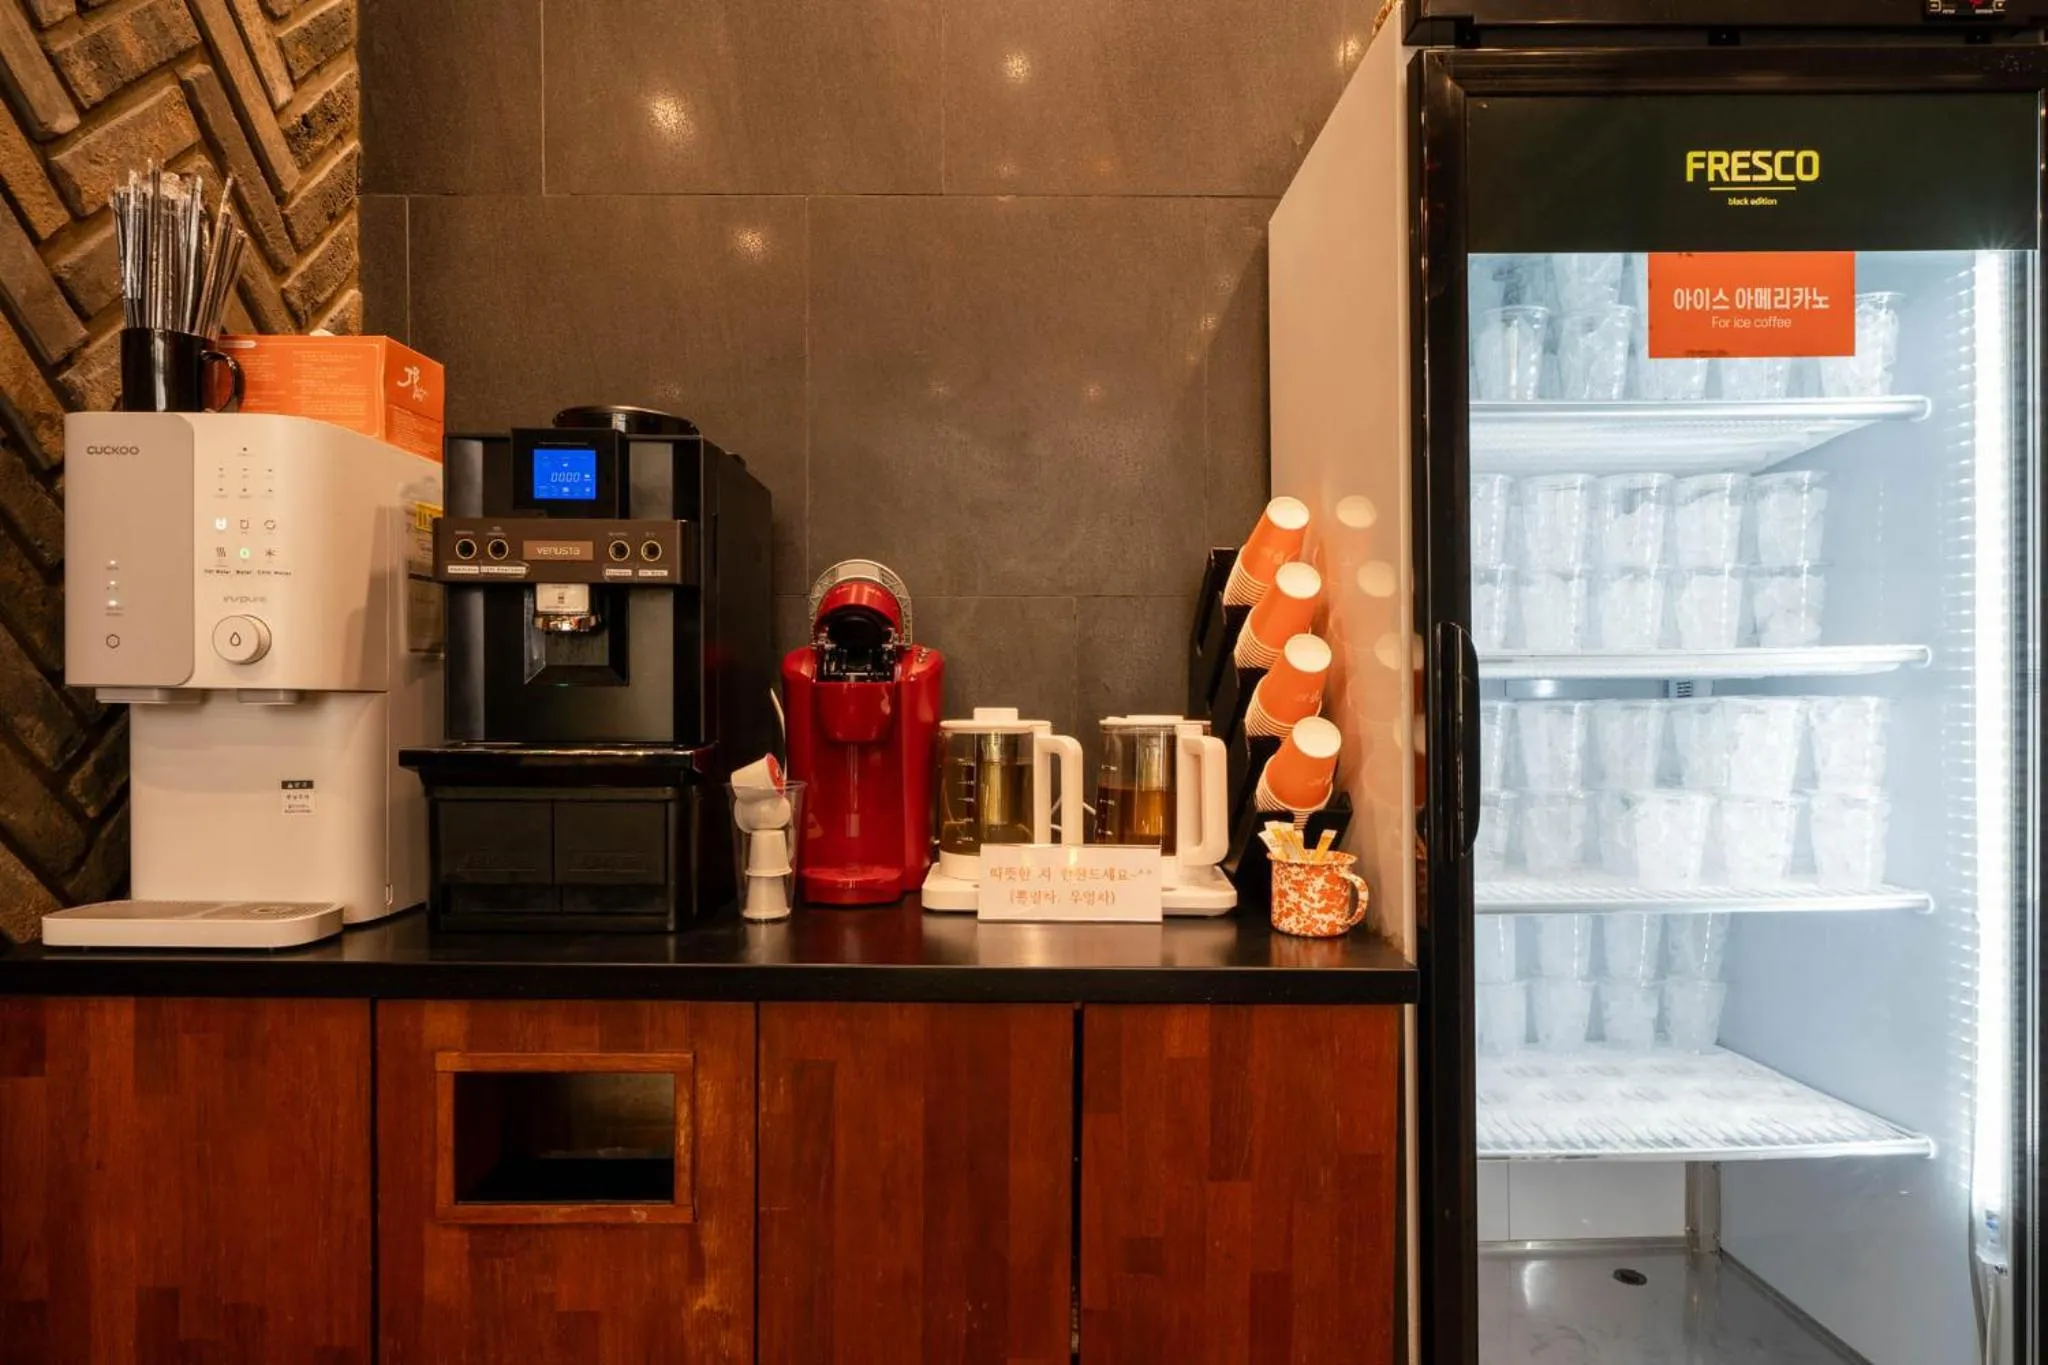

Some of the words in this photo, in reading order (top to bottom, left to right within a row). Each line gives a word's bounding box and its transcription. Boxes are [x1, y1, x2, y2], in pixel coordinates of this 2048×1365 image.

[1686, 150, 1820, 182] FRESCO
[1728, 197, 1749, 206] black
[1750, 197, 1778, 206] edition
[1673, 287, 1730, 311] 아이스
[1735, 287, 1830, 311] 아메리카노
[1711, 315, 1731, 329] For
[1733, 315, 1751, 329] ice
[1754, 315, 1792, 329] coffee
[86, 446, 140, 456] CUCKOO
